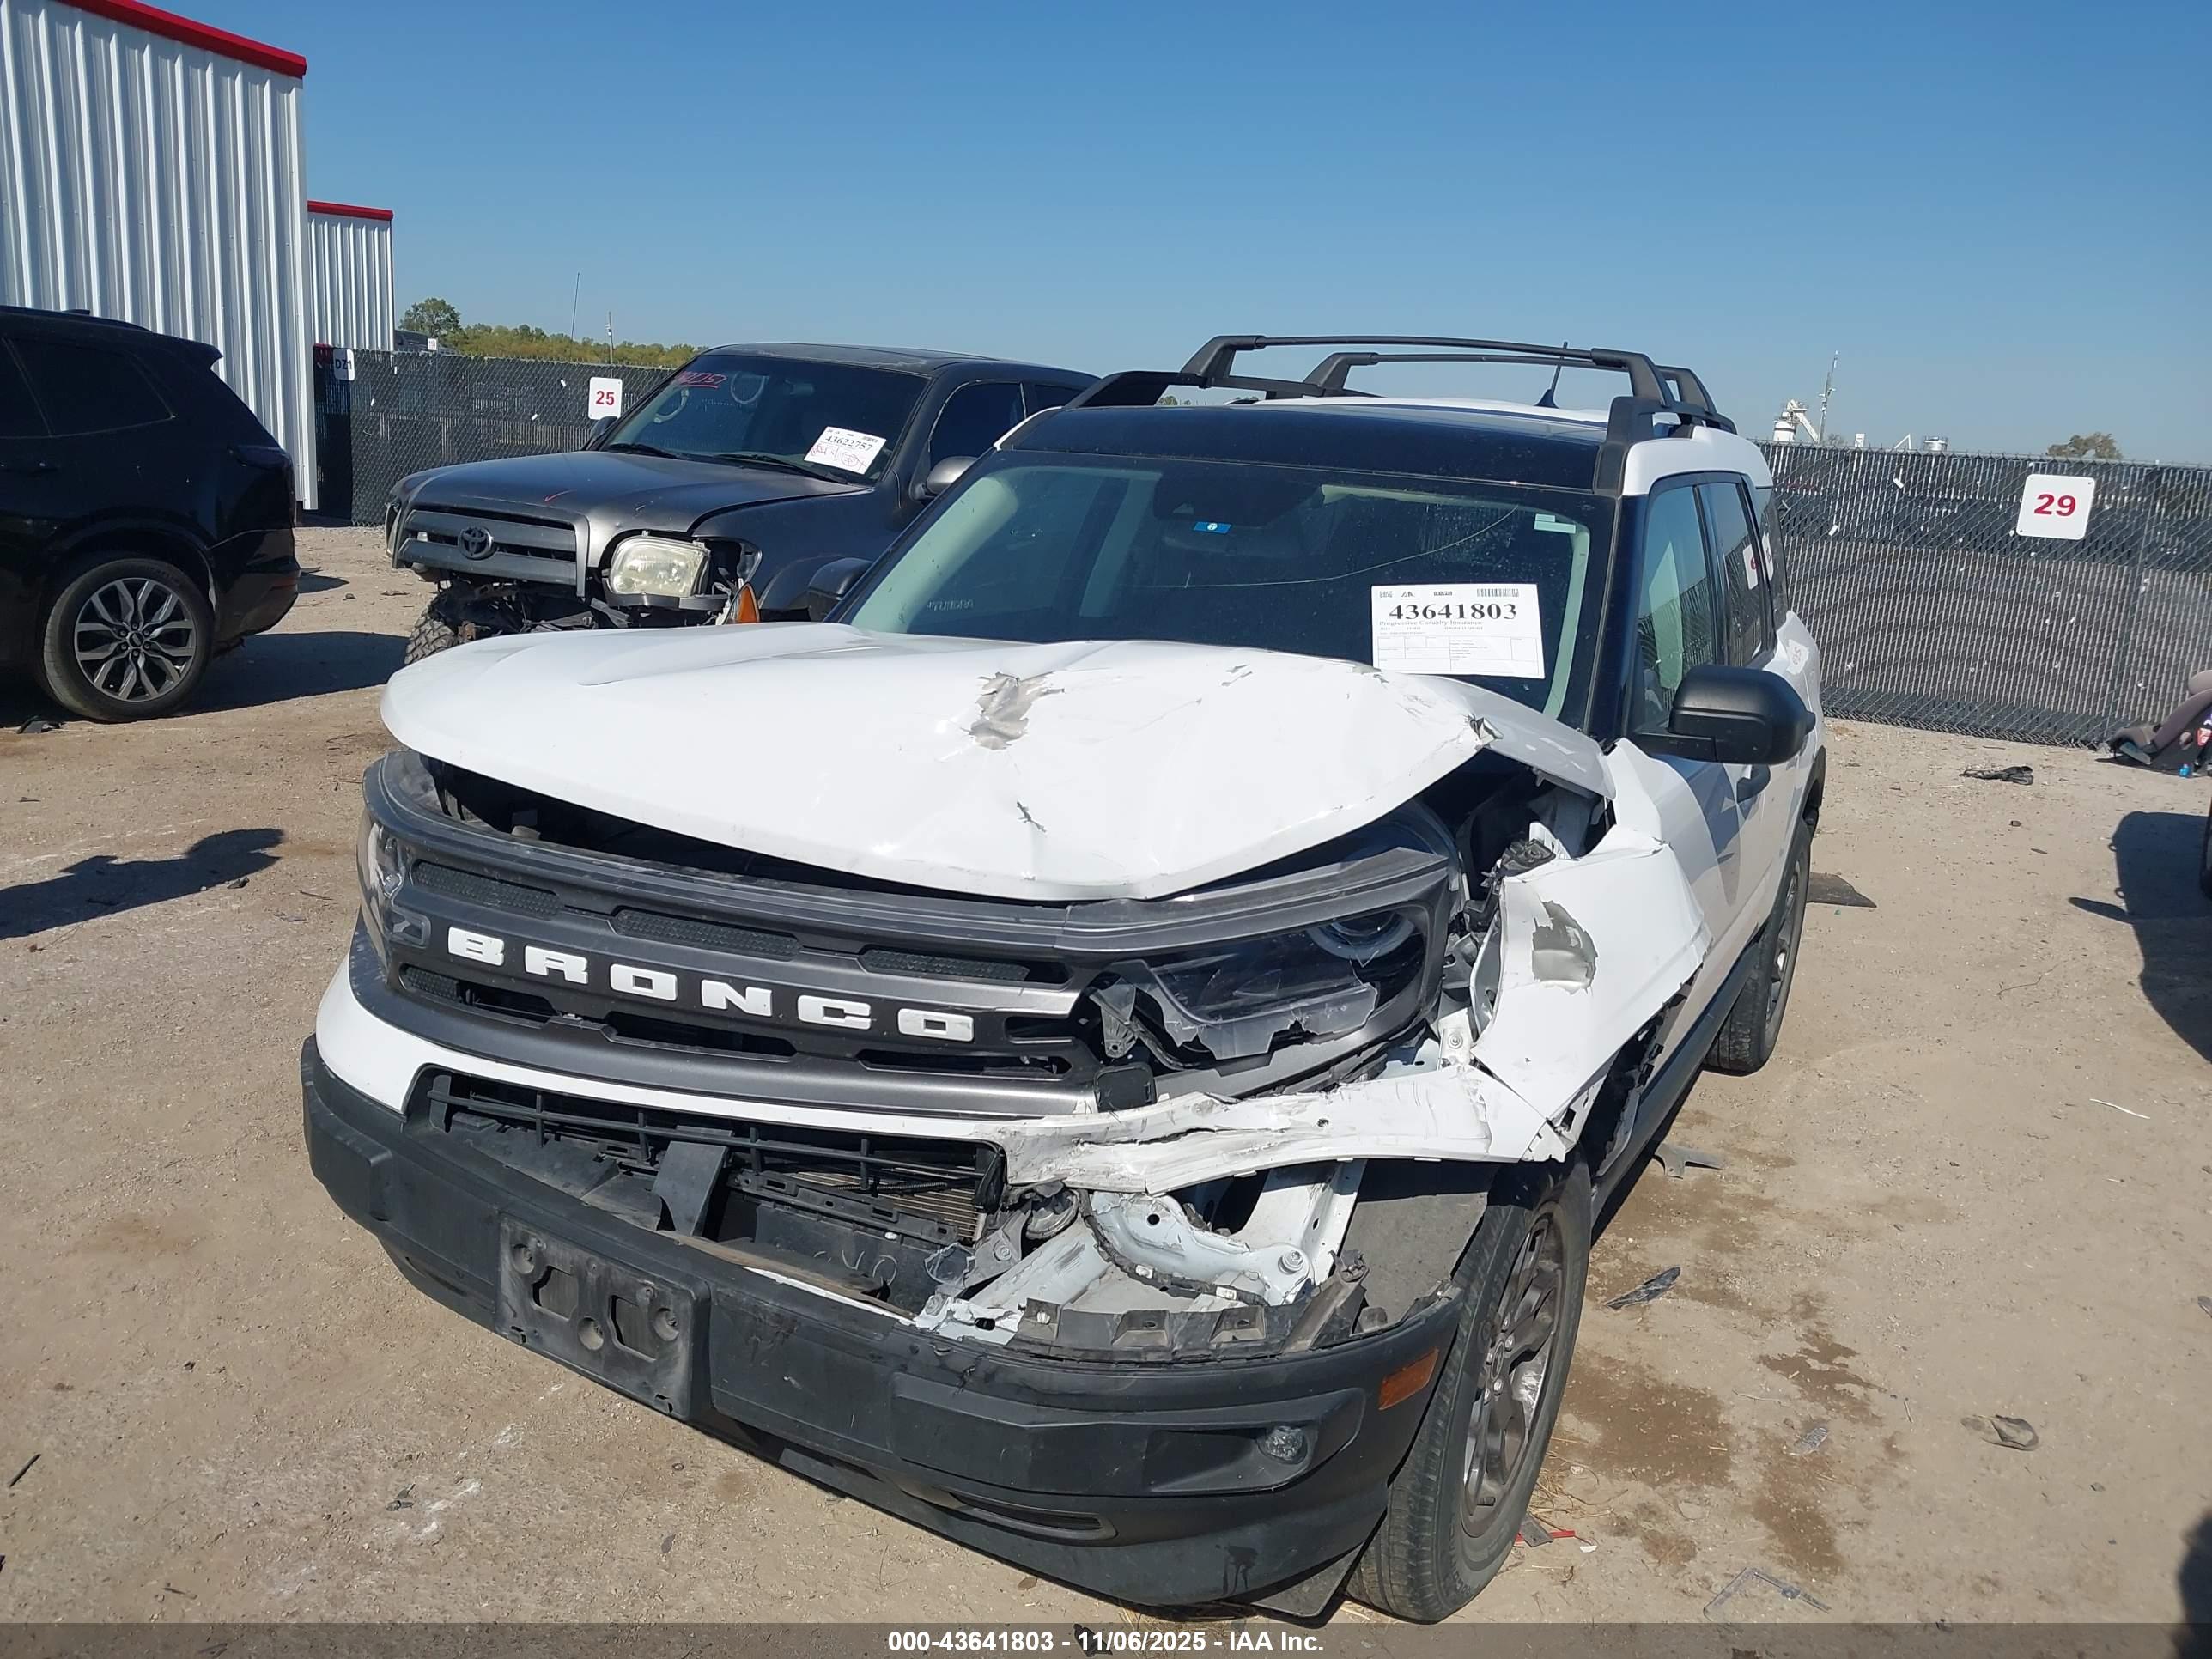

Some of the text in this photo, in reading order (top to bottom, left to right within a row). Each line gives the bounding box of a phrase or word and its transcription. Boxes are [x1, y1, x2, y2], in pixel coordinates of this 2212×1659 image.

[595, 390, 615, 406] 25
[825, 434, 873, 452] 43622757
[2033, 493, 2076, 517] 29
[1389, 603, 1517, 621] 43641803
[447, 927, 975, 1042] BRONCO
